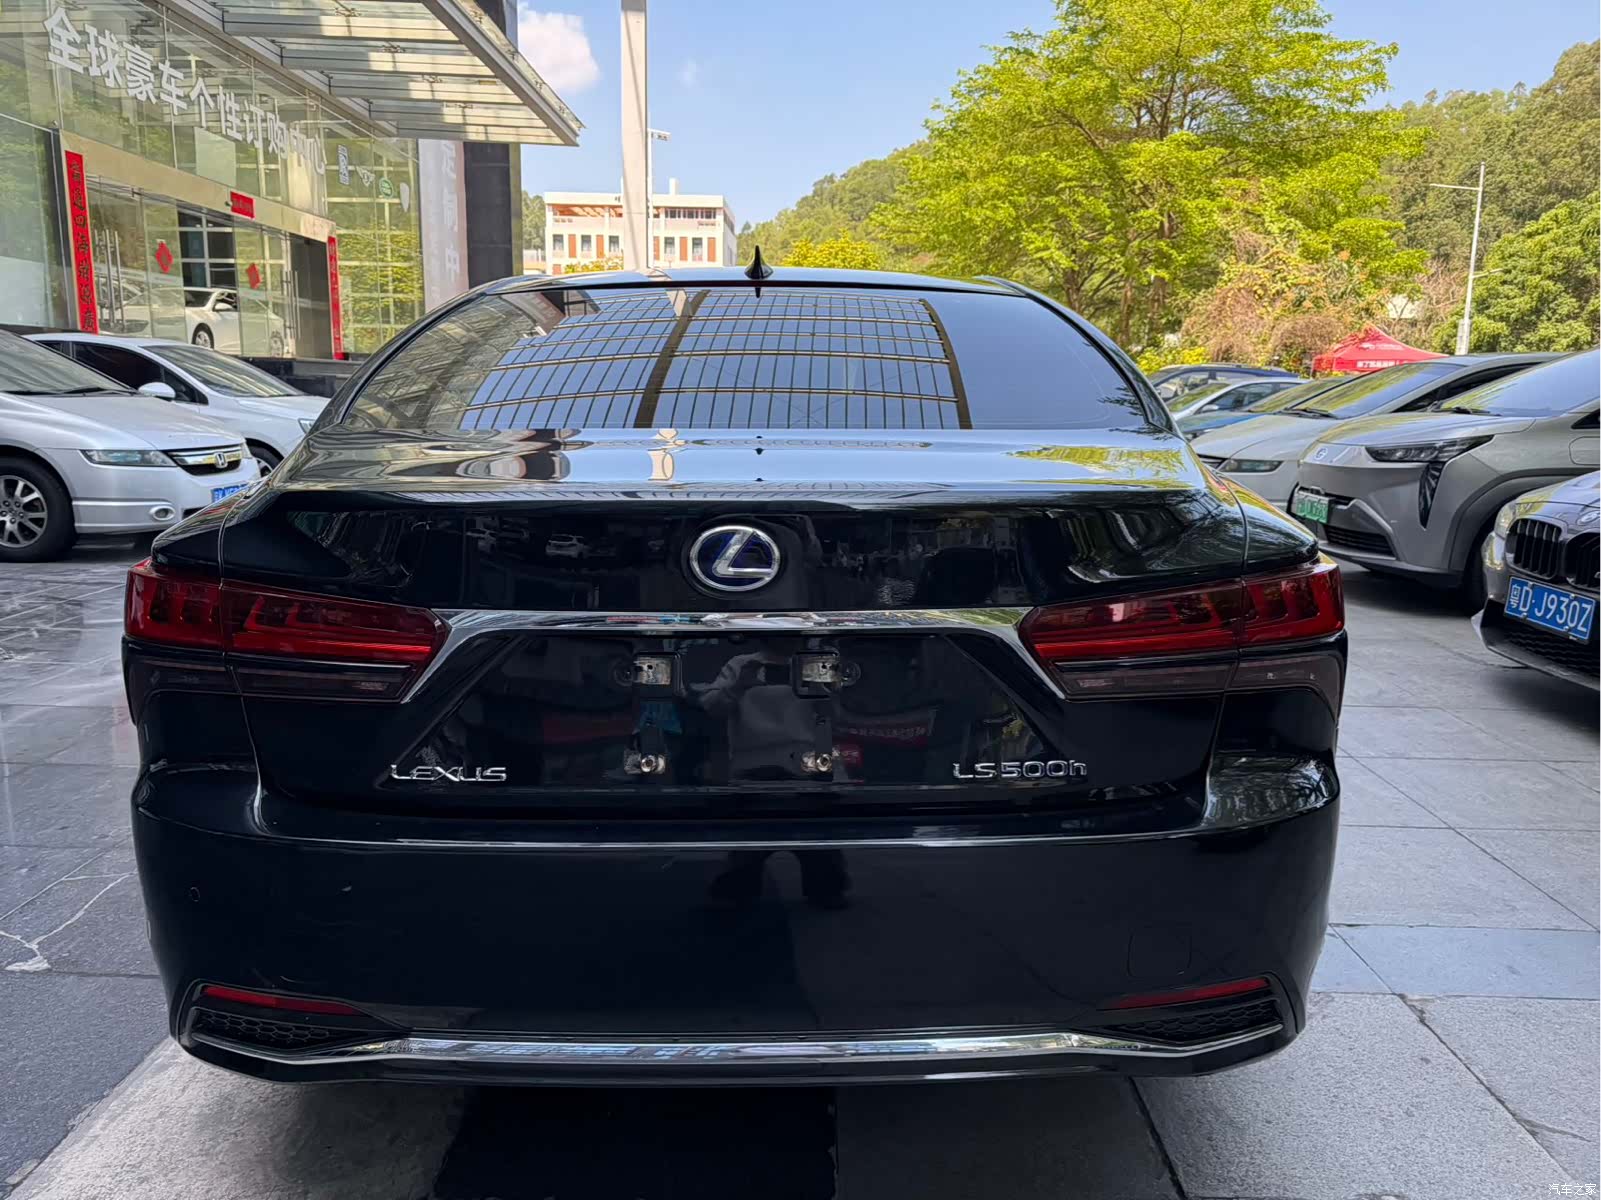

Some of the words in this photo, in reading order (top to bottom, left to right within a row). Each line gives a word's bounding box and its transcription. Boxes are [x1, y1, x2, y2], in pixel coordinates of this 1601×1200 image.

[43, 7, 327, 175] 全球豪车个性订购中心
[390, 764, 507, 782] LEXUS
